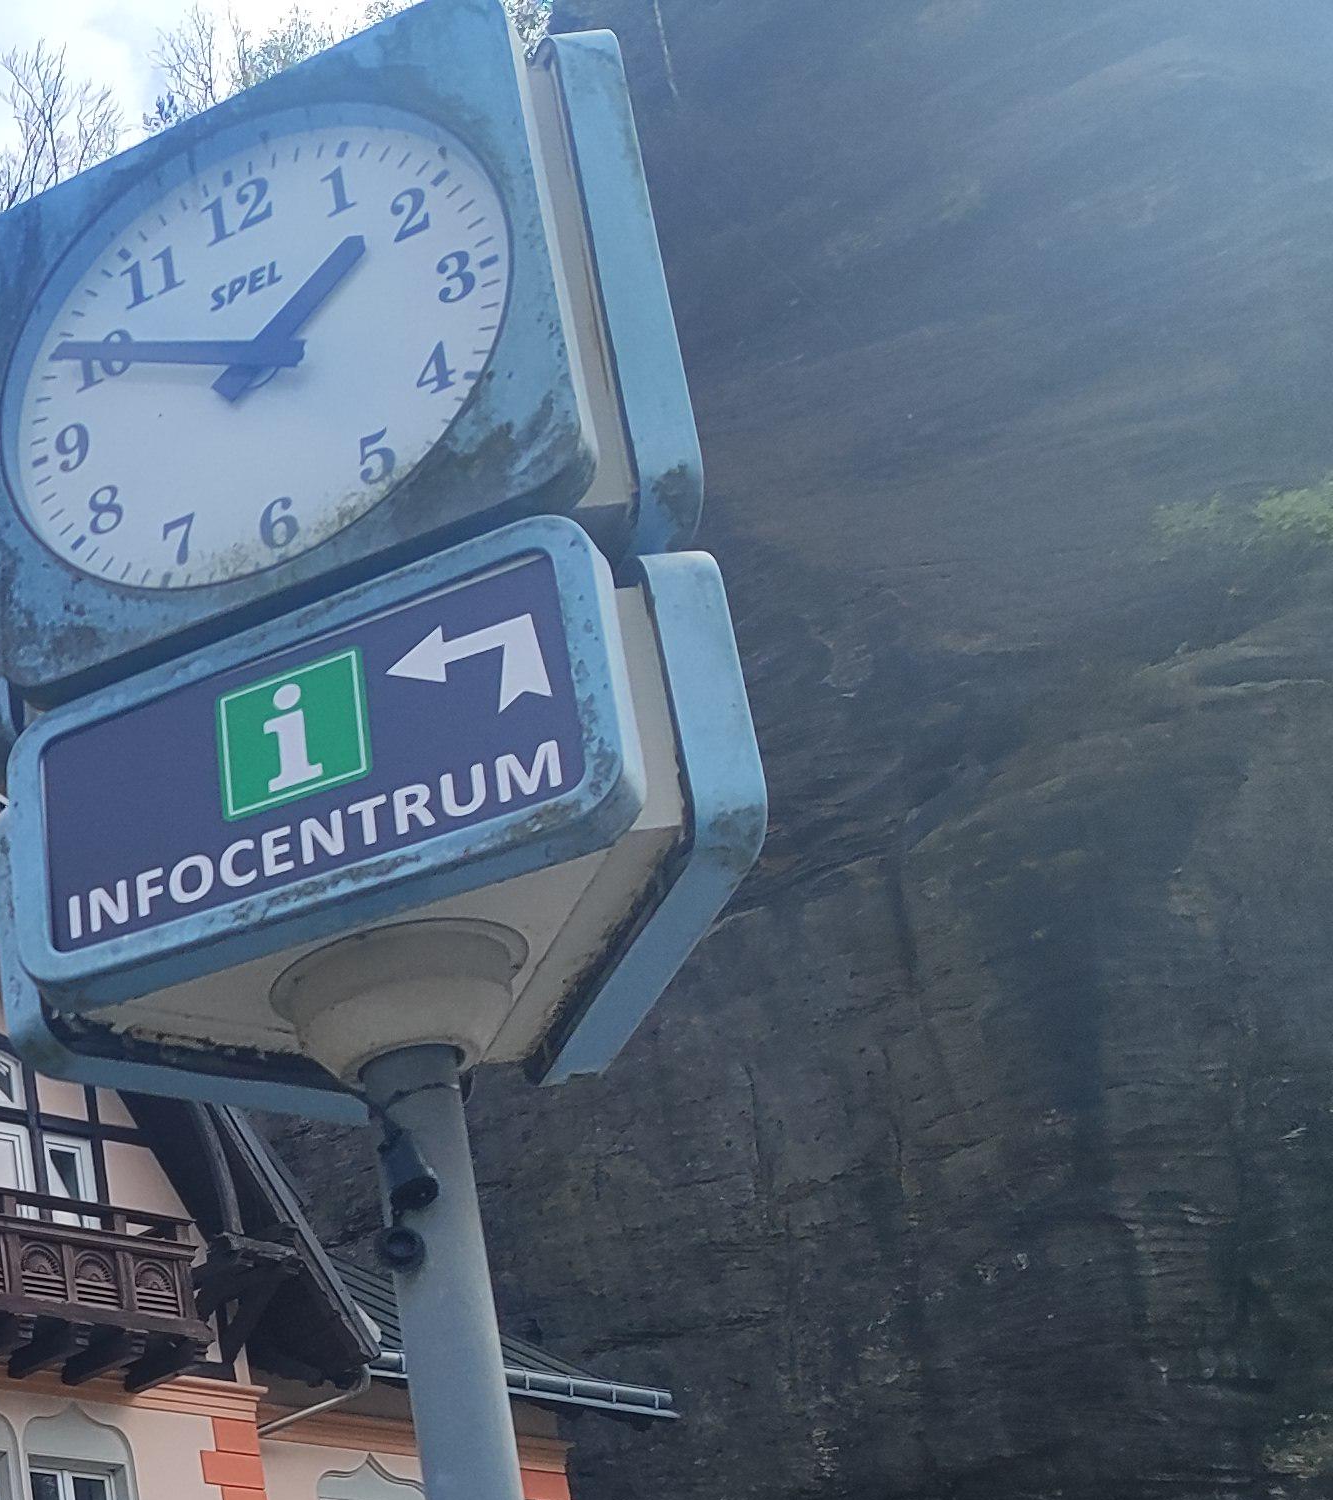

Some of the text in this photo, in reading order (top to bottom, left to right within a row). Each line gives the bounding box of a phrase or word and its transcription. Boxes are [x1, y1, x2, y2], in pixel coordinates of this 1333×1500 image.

[201, 176, 273, 248] 12
[320, 165, 357, 218] 1
[389, 187, 430, 243] 2
[119, 244, 185, 311] 11
[209, 261, 283, 312] SPEL
[436, 250, 476, 303] 3
[416, 340, 456, 394] 4
[55, 423, 90, 473] 9
[359, 427, 396, 485] 5
[88, 484, 124, 535] 8
[259, 497, 299, 549] 6
[162, 512, 195, 566] 7
[67, 739, 563, 940] INFOCENTRUM
